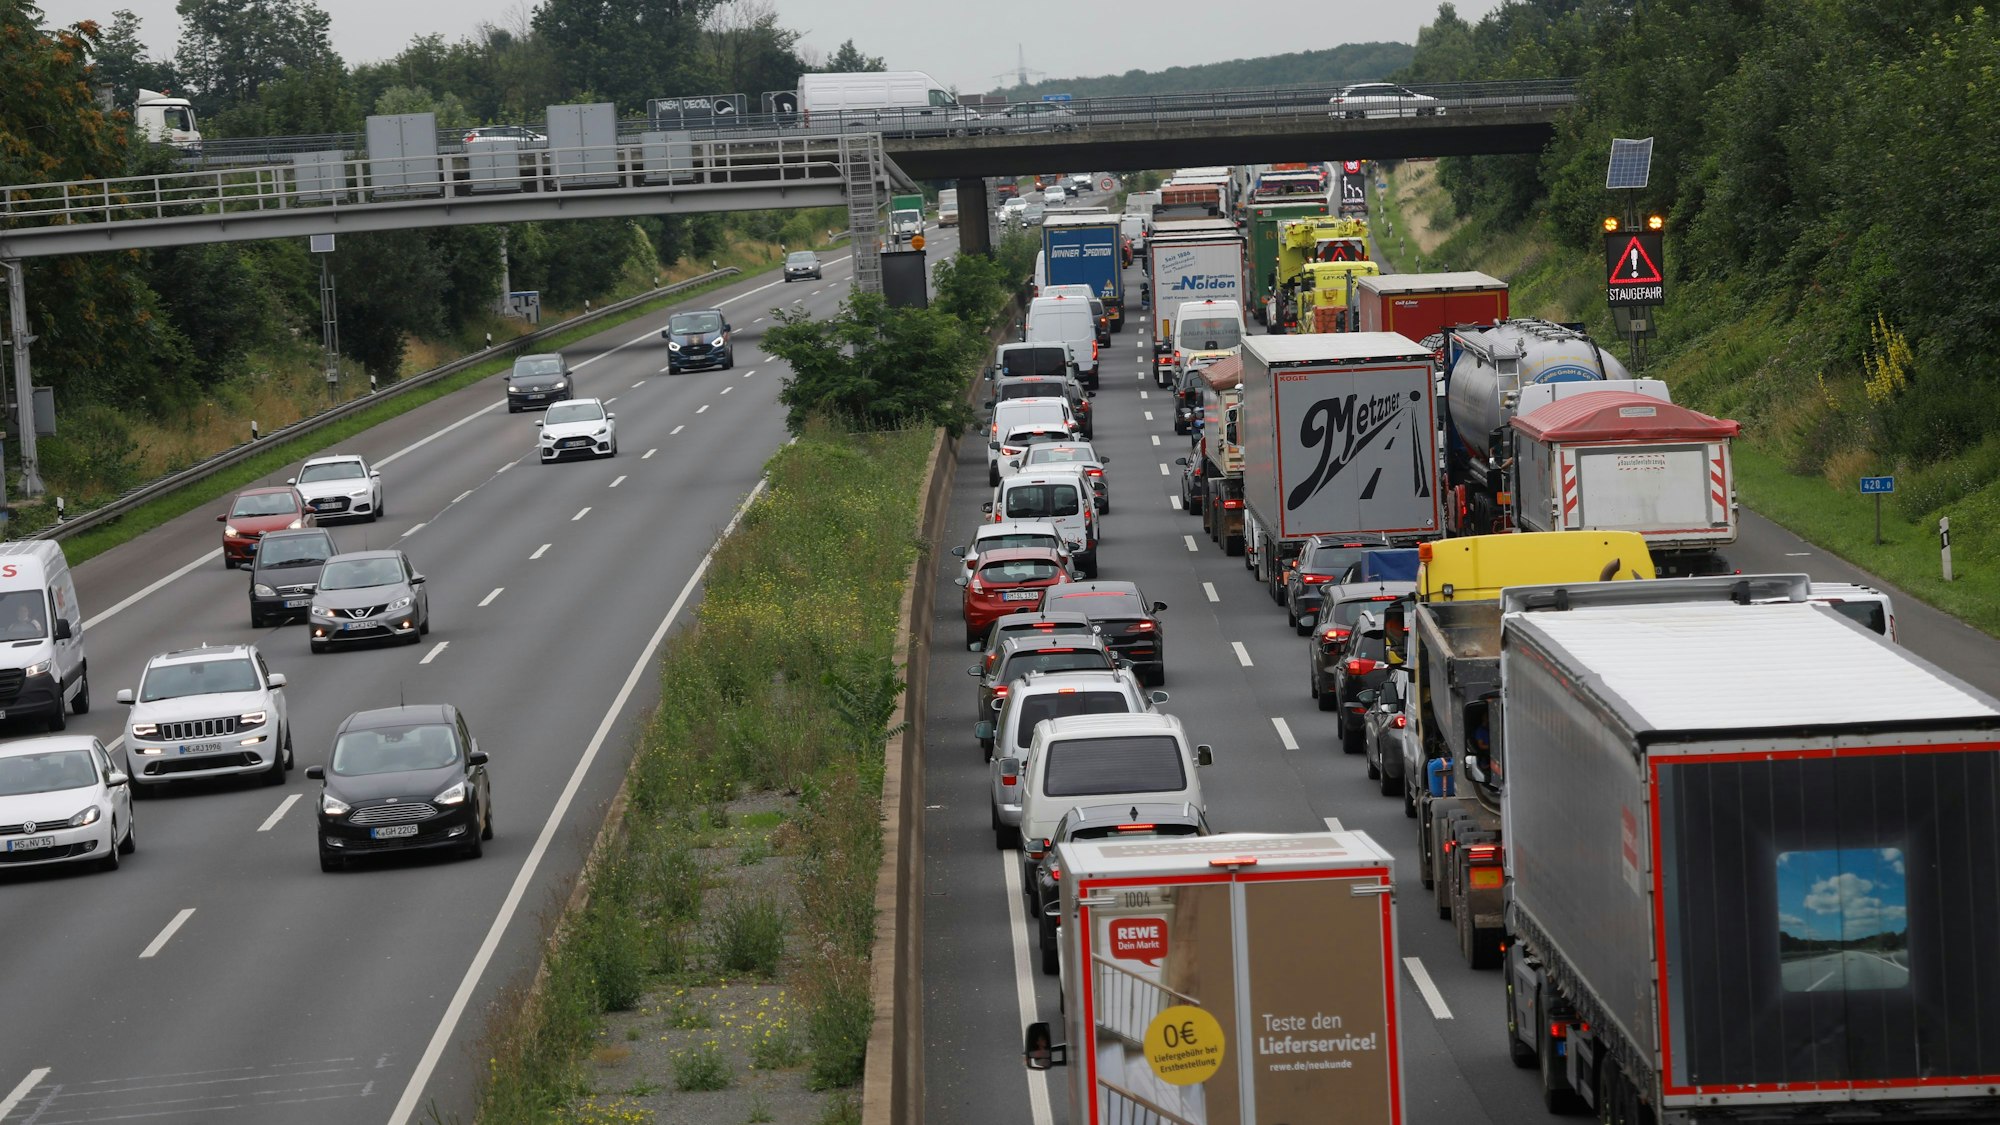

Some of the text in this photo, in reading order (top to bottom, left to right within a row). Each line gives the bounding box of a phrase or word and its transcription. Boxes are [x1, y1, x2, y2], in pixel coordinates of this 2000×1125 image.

[1051, 243, 1112, 258] WINNER SPEDITION
[1178, 275, 1236, 290] Nolden
[1101, 290, 1114, 298] 721
[1609, 286, 1662, 301] STAUGEFAHR
[1287, 391, 1400, 510] Metzner
[385, 828, 396, 836] GH
[397, 825, 417, 835] 2205
[14, 838, 51, 849] MS NV 15
[1124, 891, 1151, 908] 1004
[1117, 926, 1159, 940] REWE
[1118, 941, 1160, 950] Dein Markt
[1262, 1012, 1342, 1032] Teste den
[1163, 1021, 1198, 1048] 0€
[1259, 1032, 1376, 1055] Lieferservice!
[1154, 1045, 1218, 1063] Liefergebühr bei
[1160, 1058, 1217, 1073] Erstbestellung
[1269, 1060, 1353, 1072] rewe.de/neukunde
